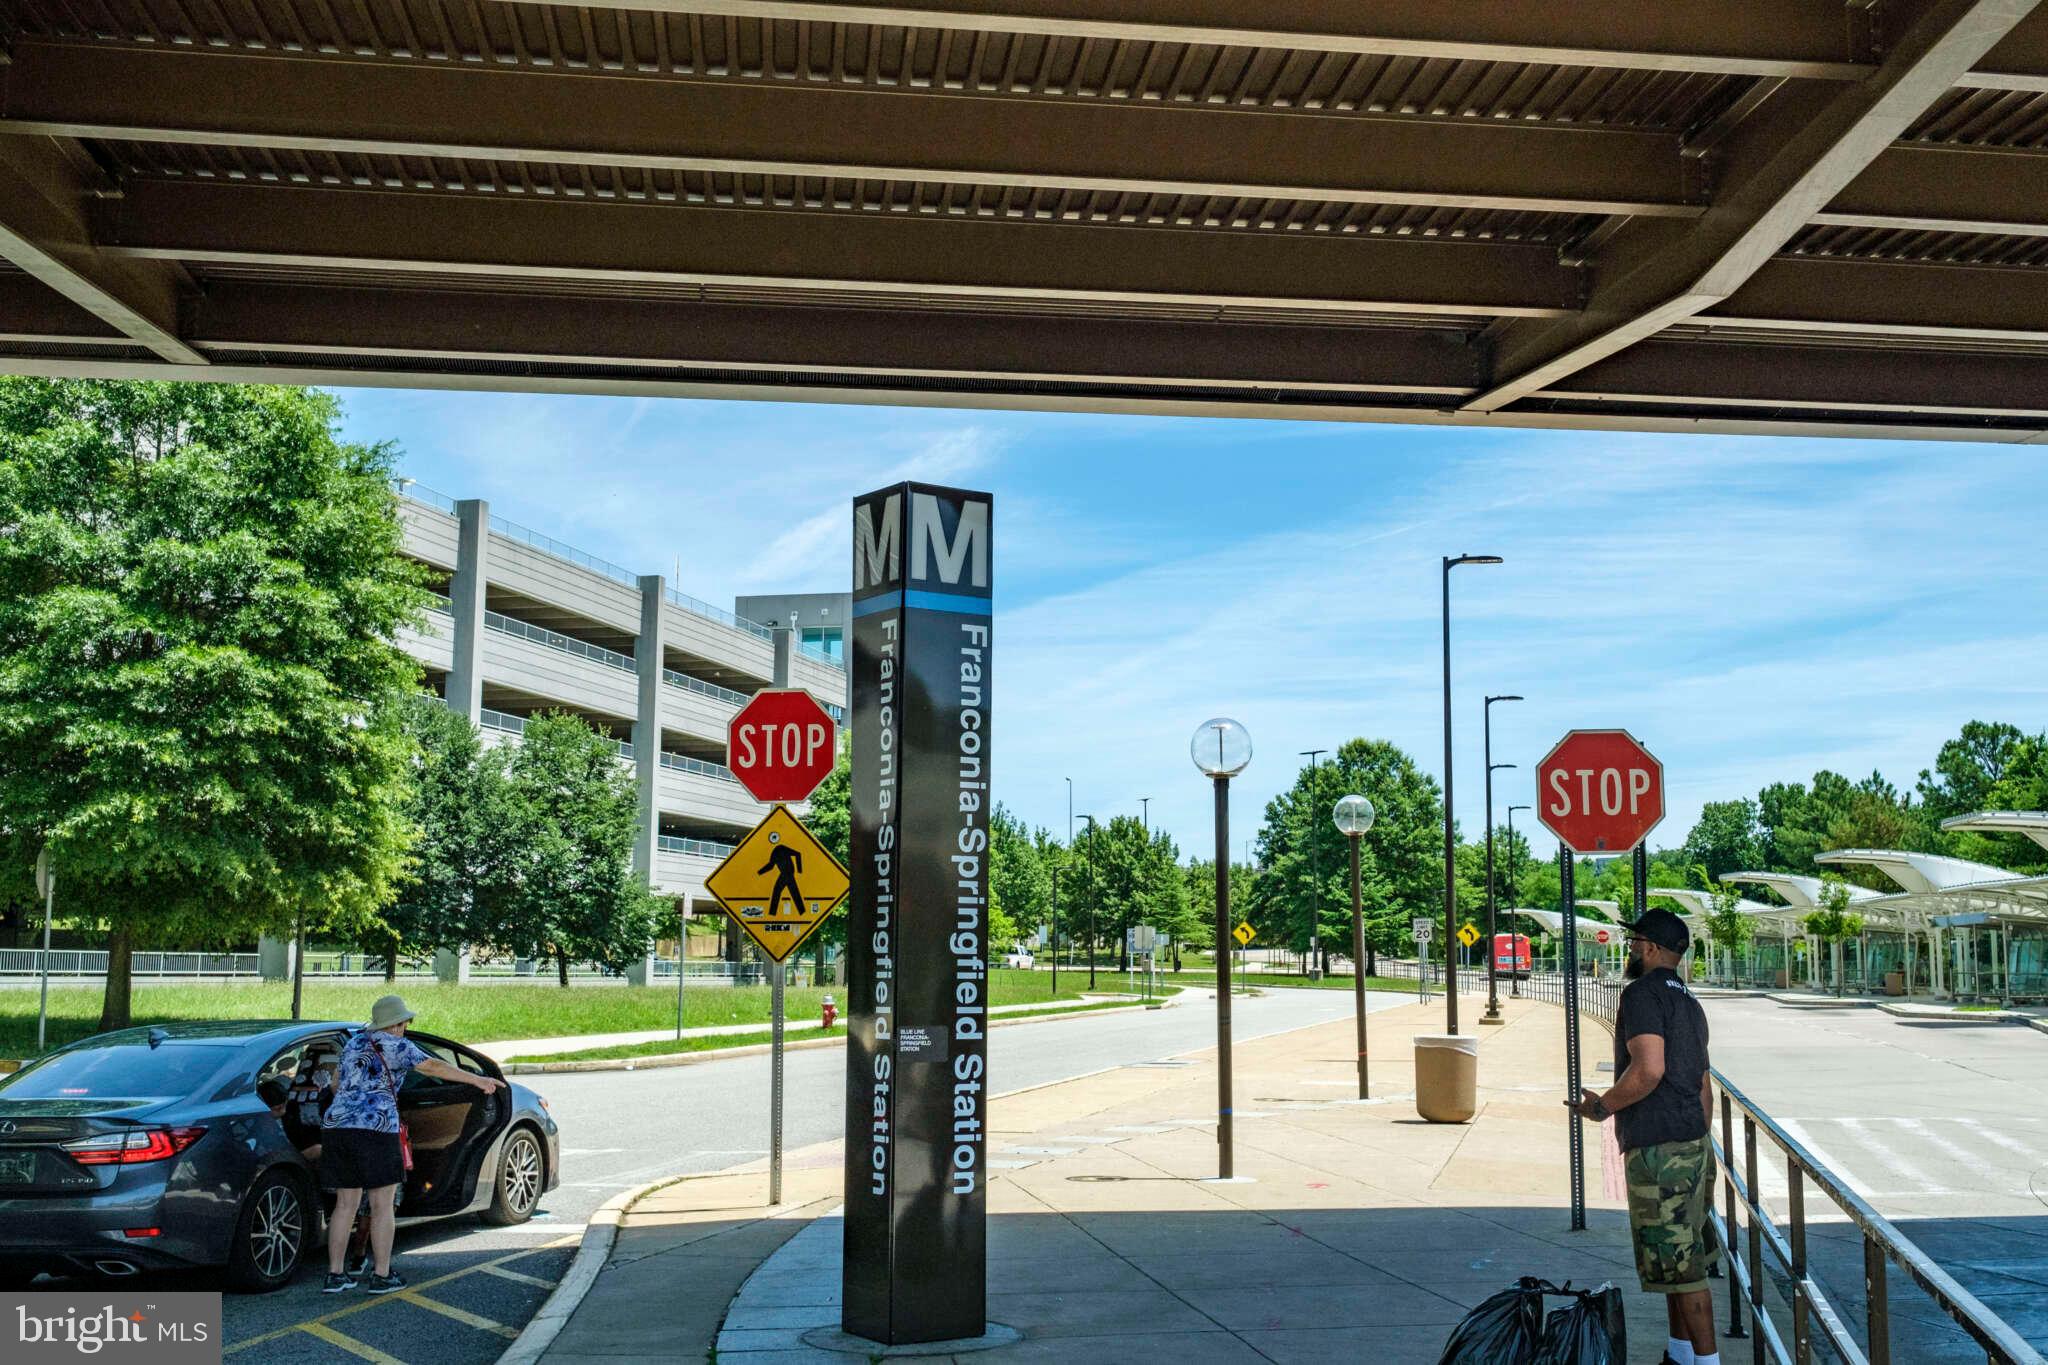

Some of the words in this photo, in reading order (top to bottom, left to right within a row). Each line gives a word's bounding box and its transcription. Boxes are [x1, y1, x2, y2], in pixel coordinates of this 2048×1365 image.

[855, 492, 901, 591] M
[911, 492, 988, 587] M
[737, 723, 826, 768] STOP
[1549, 767, 1651, 817] STOP
[871, 616, 898, 1041] Franconia-Springfield
[950, 623, 988, 1040] Franconia-Springfield
[1416, 930, 1430, 939] 20
[871, 1054, 891, 1196] Station
[952, 1053, 983, 1195] Station
